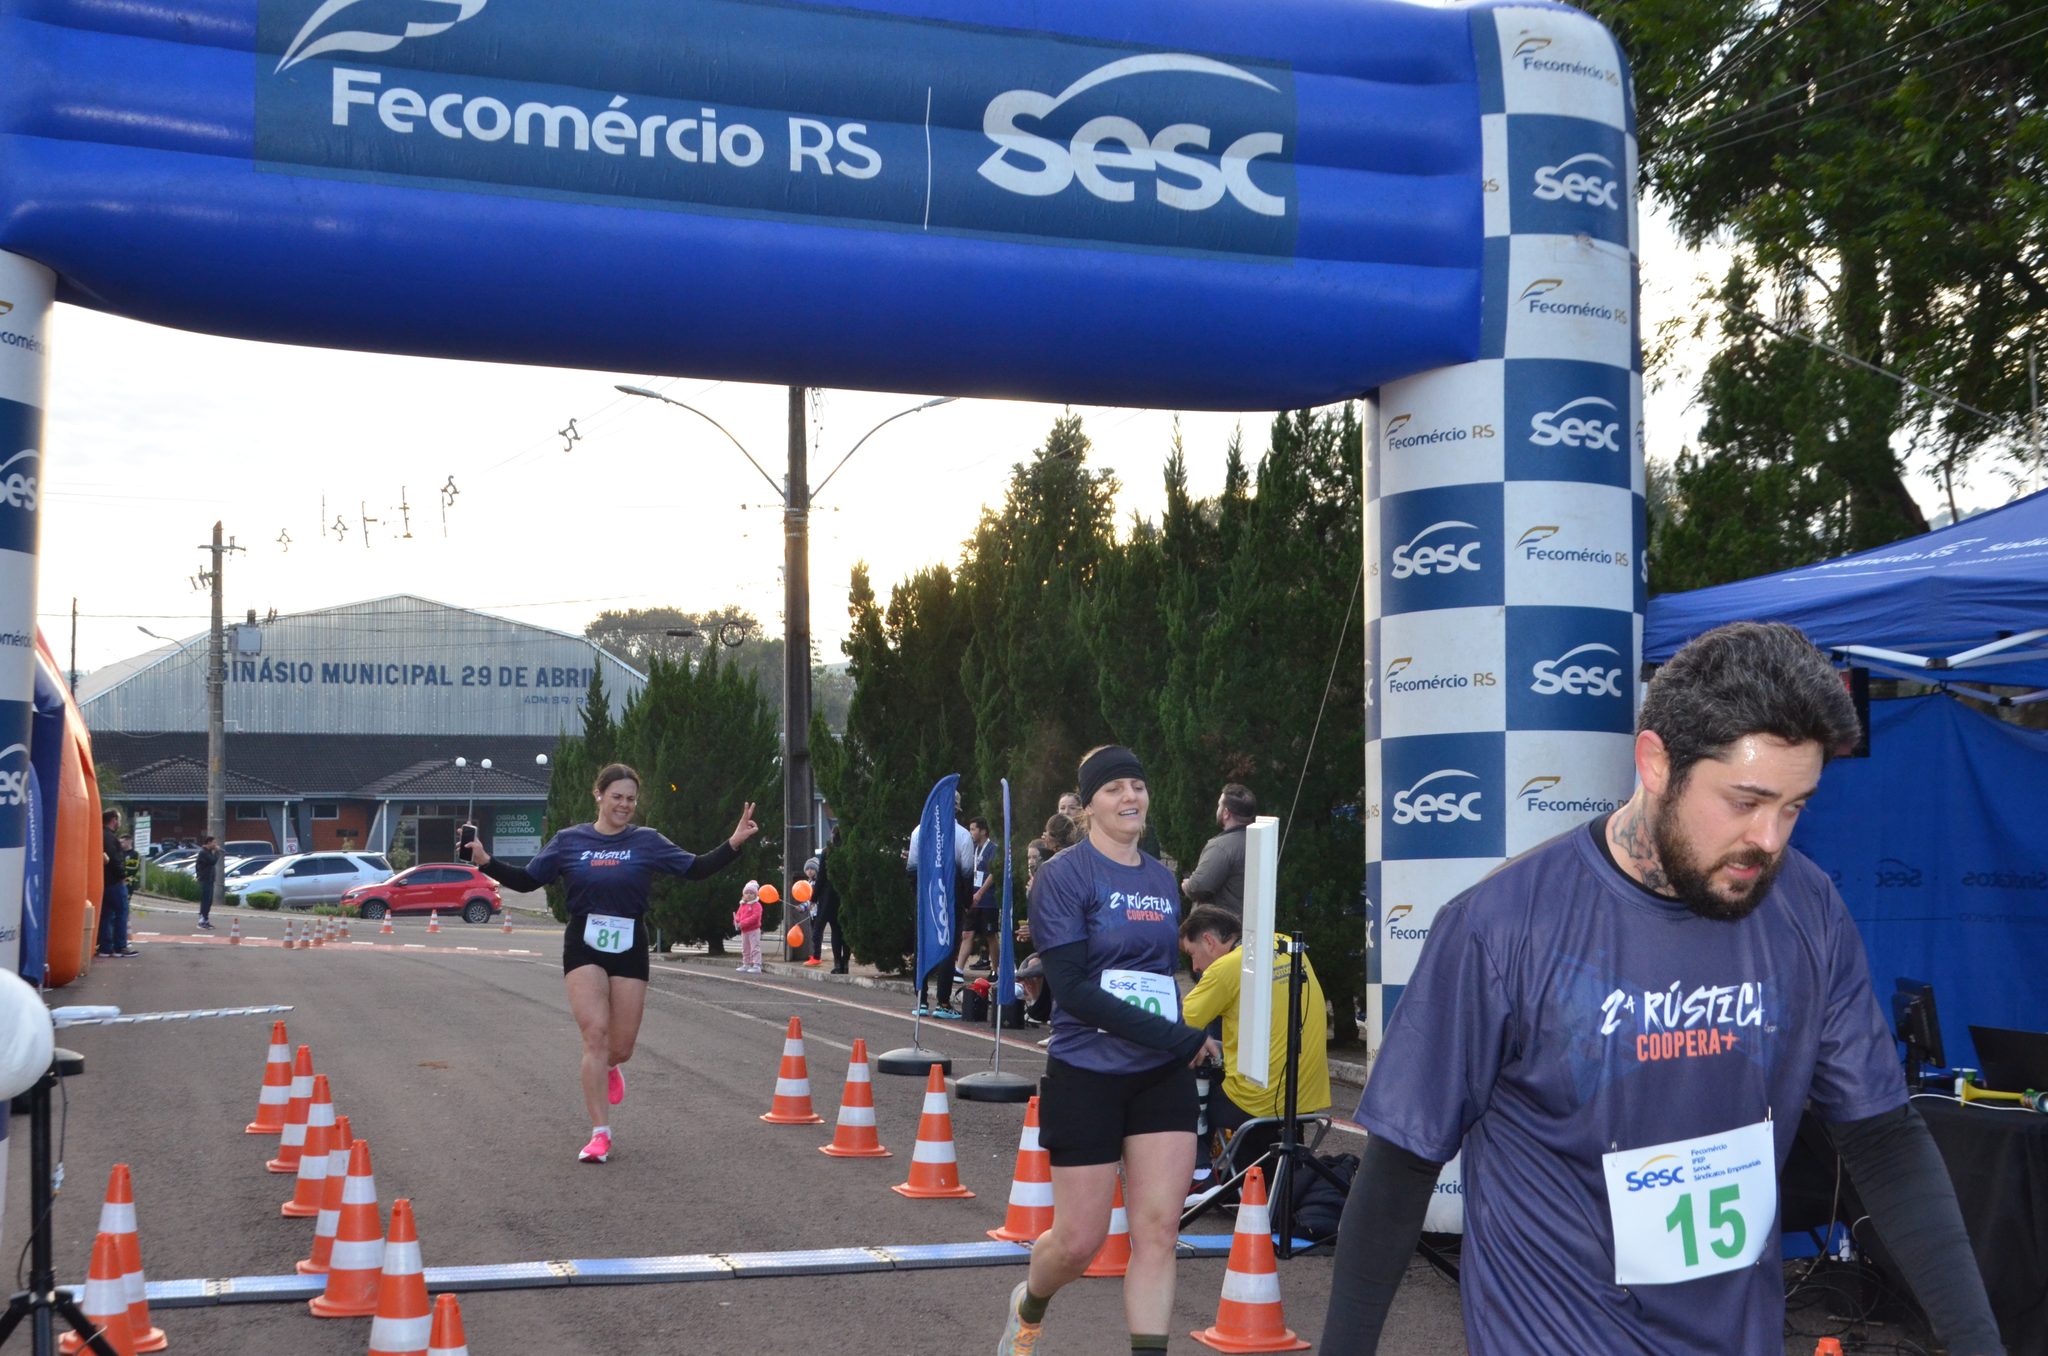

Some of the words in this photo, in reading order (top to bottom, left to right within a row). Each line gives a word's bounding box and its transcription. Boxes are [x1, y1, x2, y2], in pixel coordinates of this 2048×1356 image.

[1523, 56, 1604, 80] Fecomércio
[332, 67, 764, 167] Fecomércio
[789, 117, 882, 179] RS
[977, 88, 1286, 217] Sesc
[1529, 299, 1612, 320] Fecomércio
[1614, 308, 1628, 325] RS
[1388, 428, 1467, 450] Fecomércio
[1471, 424, 1496, 439] RS
[1526, 546, 1612, 564] Fecomércio
[1615, 551, 1629, 567] RS
[321, 662, 453, 686] MUNICIPAL
[462, 665, 491, 687] 29
[499, 666, 528, 688] DE
[1389, 675, 1468, 694] Fecomércio
[1473, 672, 1497, 687] RS
[1527, 796, 1614, 813] Fecomércio
[1127, 891, 1173, 915] RÚSTICA
[597, 928, 621, 950] 81
[1665, 1183, 1747, 1268] 15
